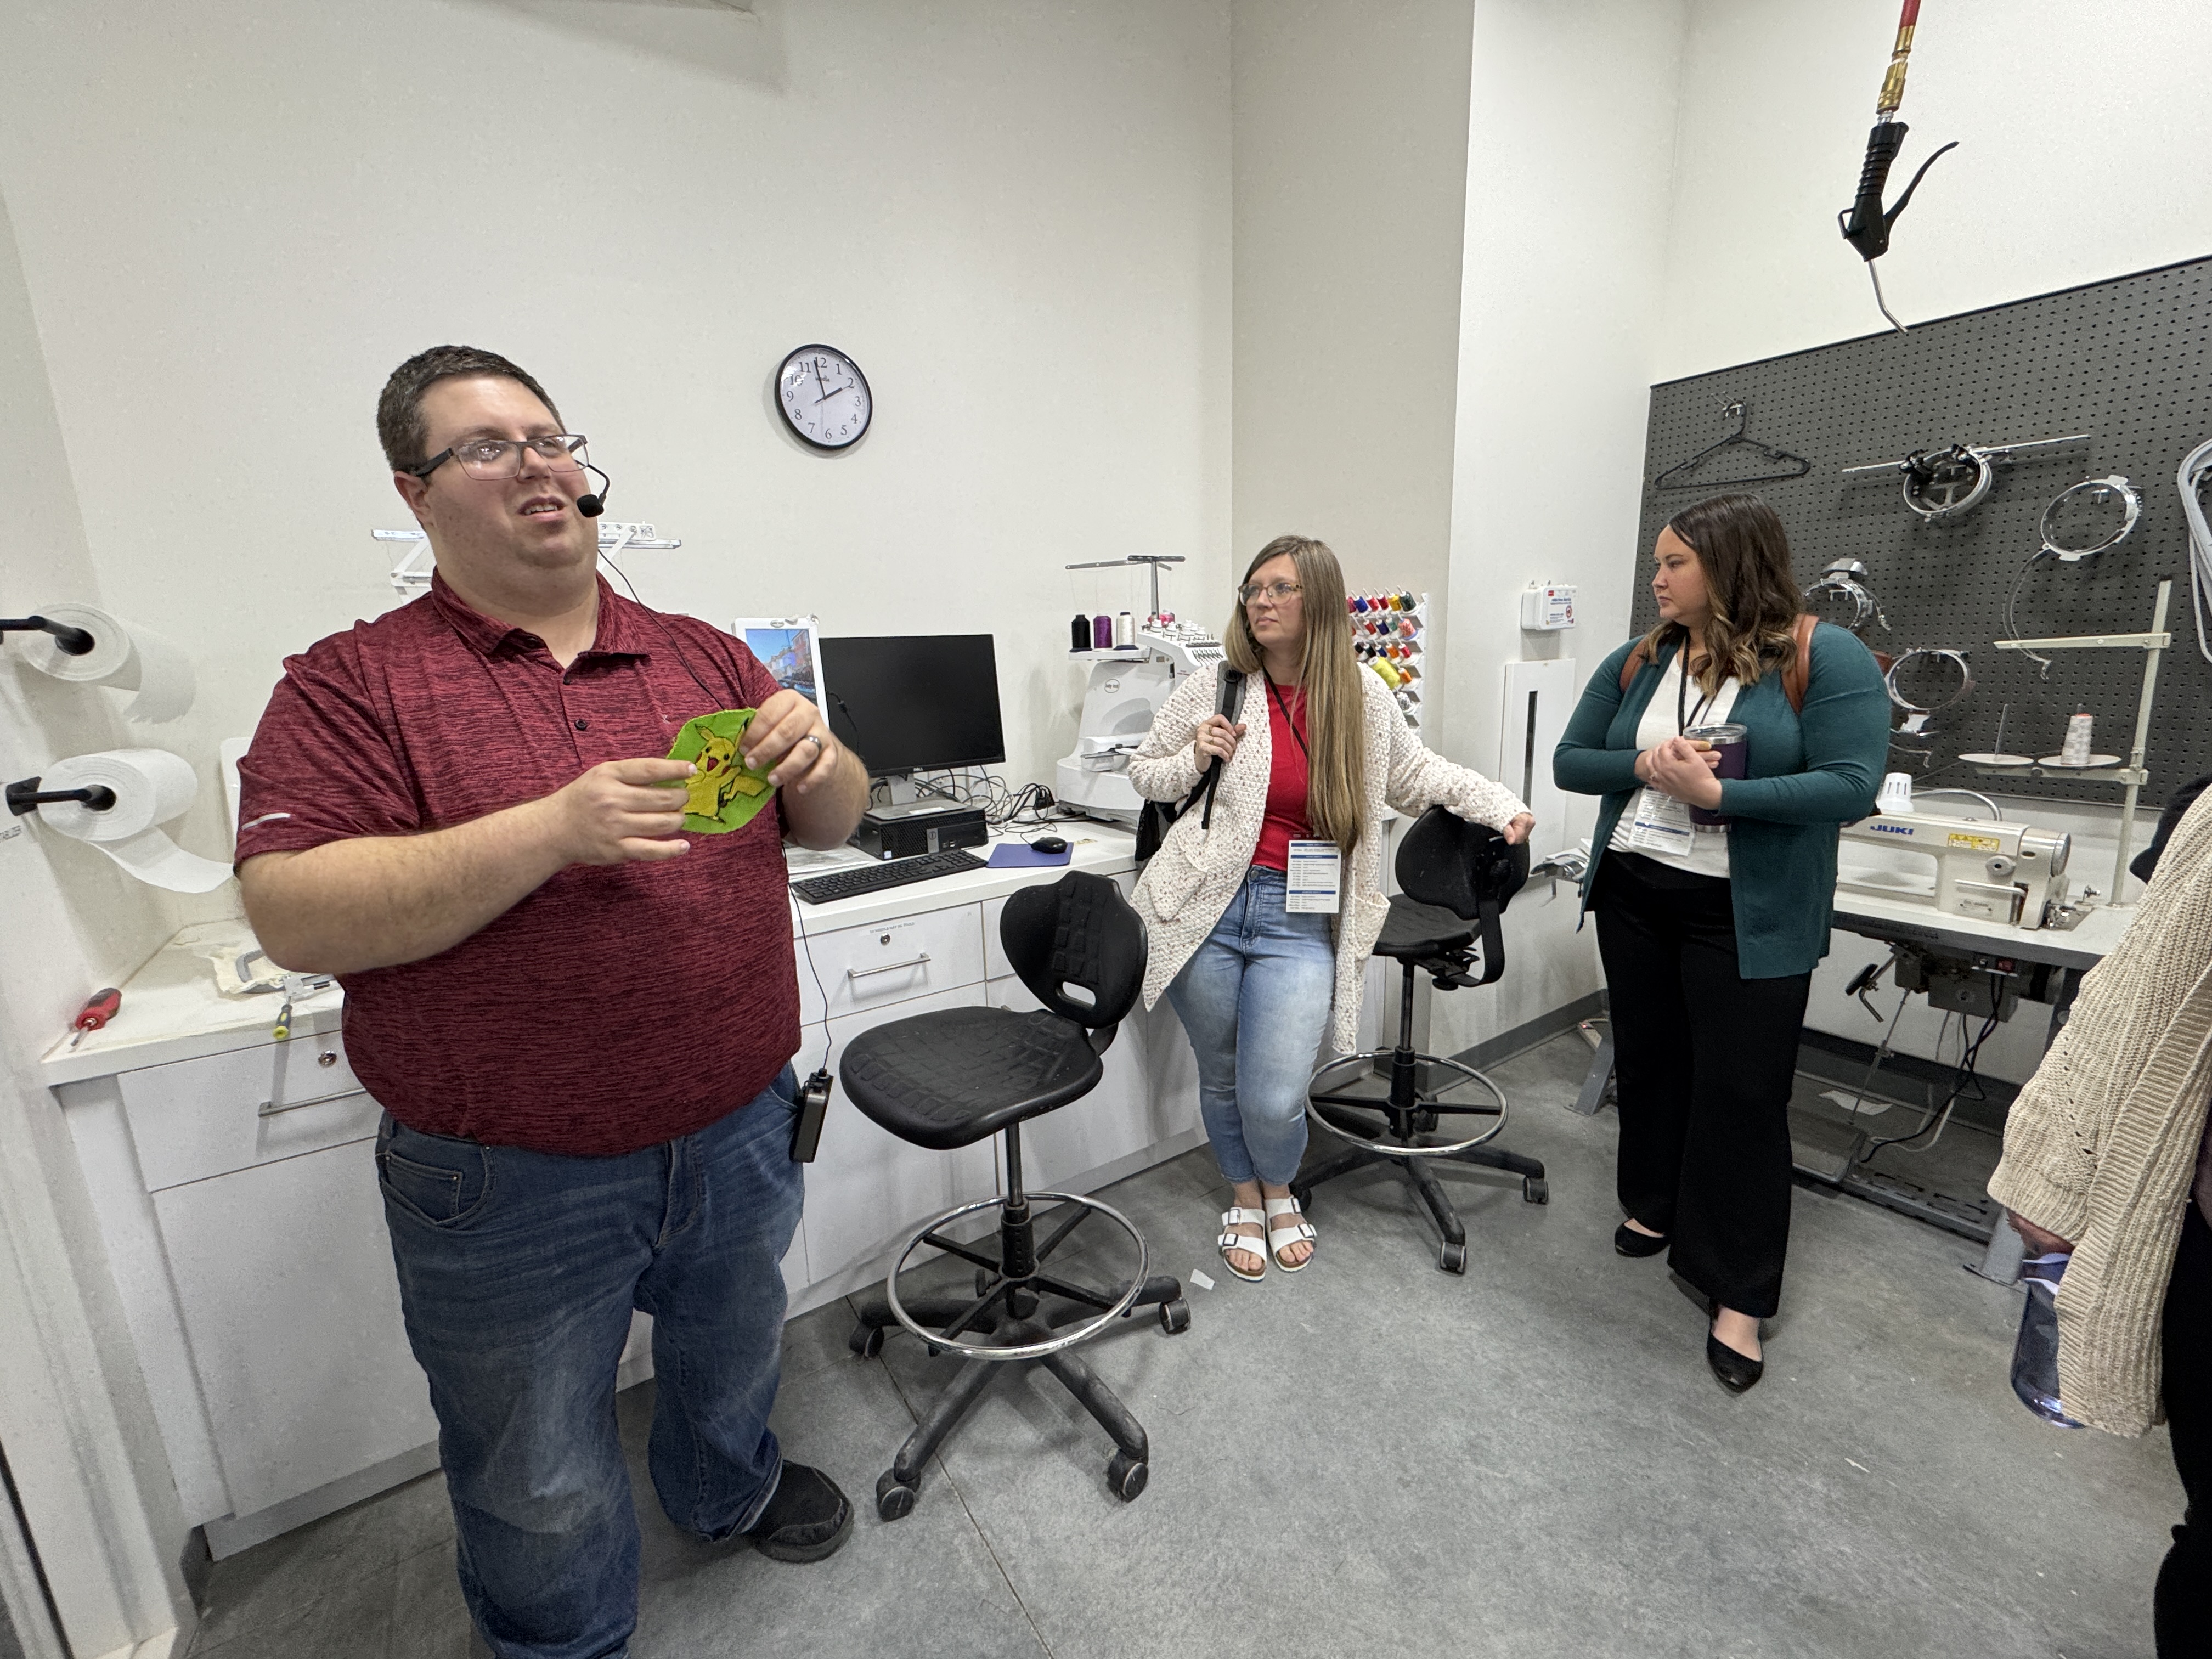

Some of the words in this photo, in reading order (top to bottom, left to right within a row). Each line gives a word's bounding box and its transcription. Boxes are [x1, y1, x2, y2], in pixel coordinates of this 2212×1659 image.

[798, 361, 811, 373] 11
[814, 357, 828, 368] 12
[835, 363, 843, 375] 1
[848, 377, 855, 388] 2
[786, 390, 794, 402] 9
[854, 396, 861, 407] 3
[794, 408, 803, 420] 8
[850, 413, 858, 424] 4
[808, 422, 815, 433] 7
[840, 425, 848, 436] 5
[825, 428, 832, 439] 6
[1870, 825, 1914, 835] JUKI
